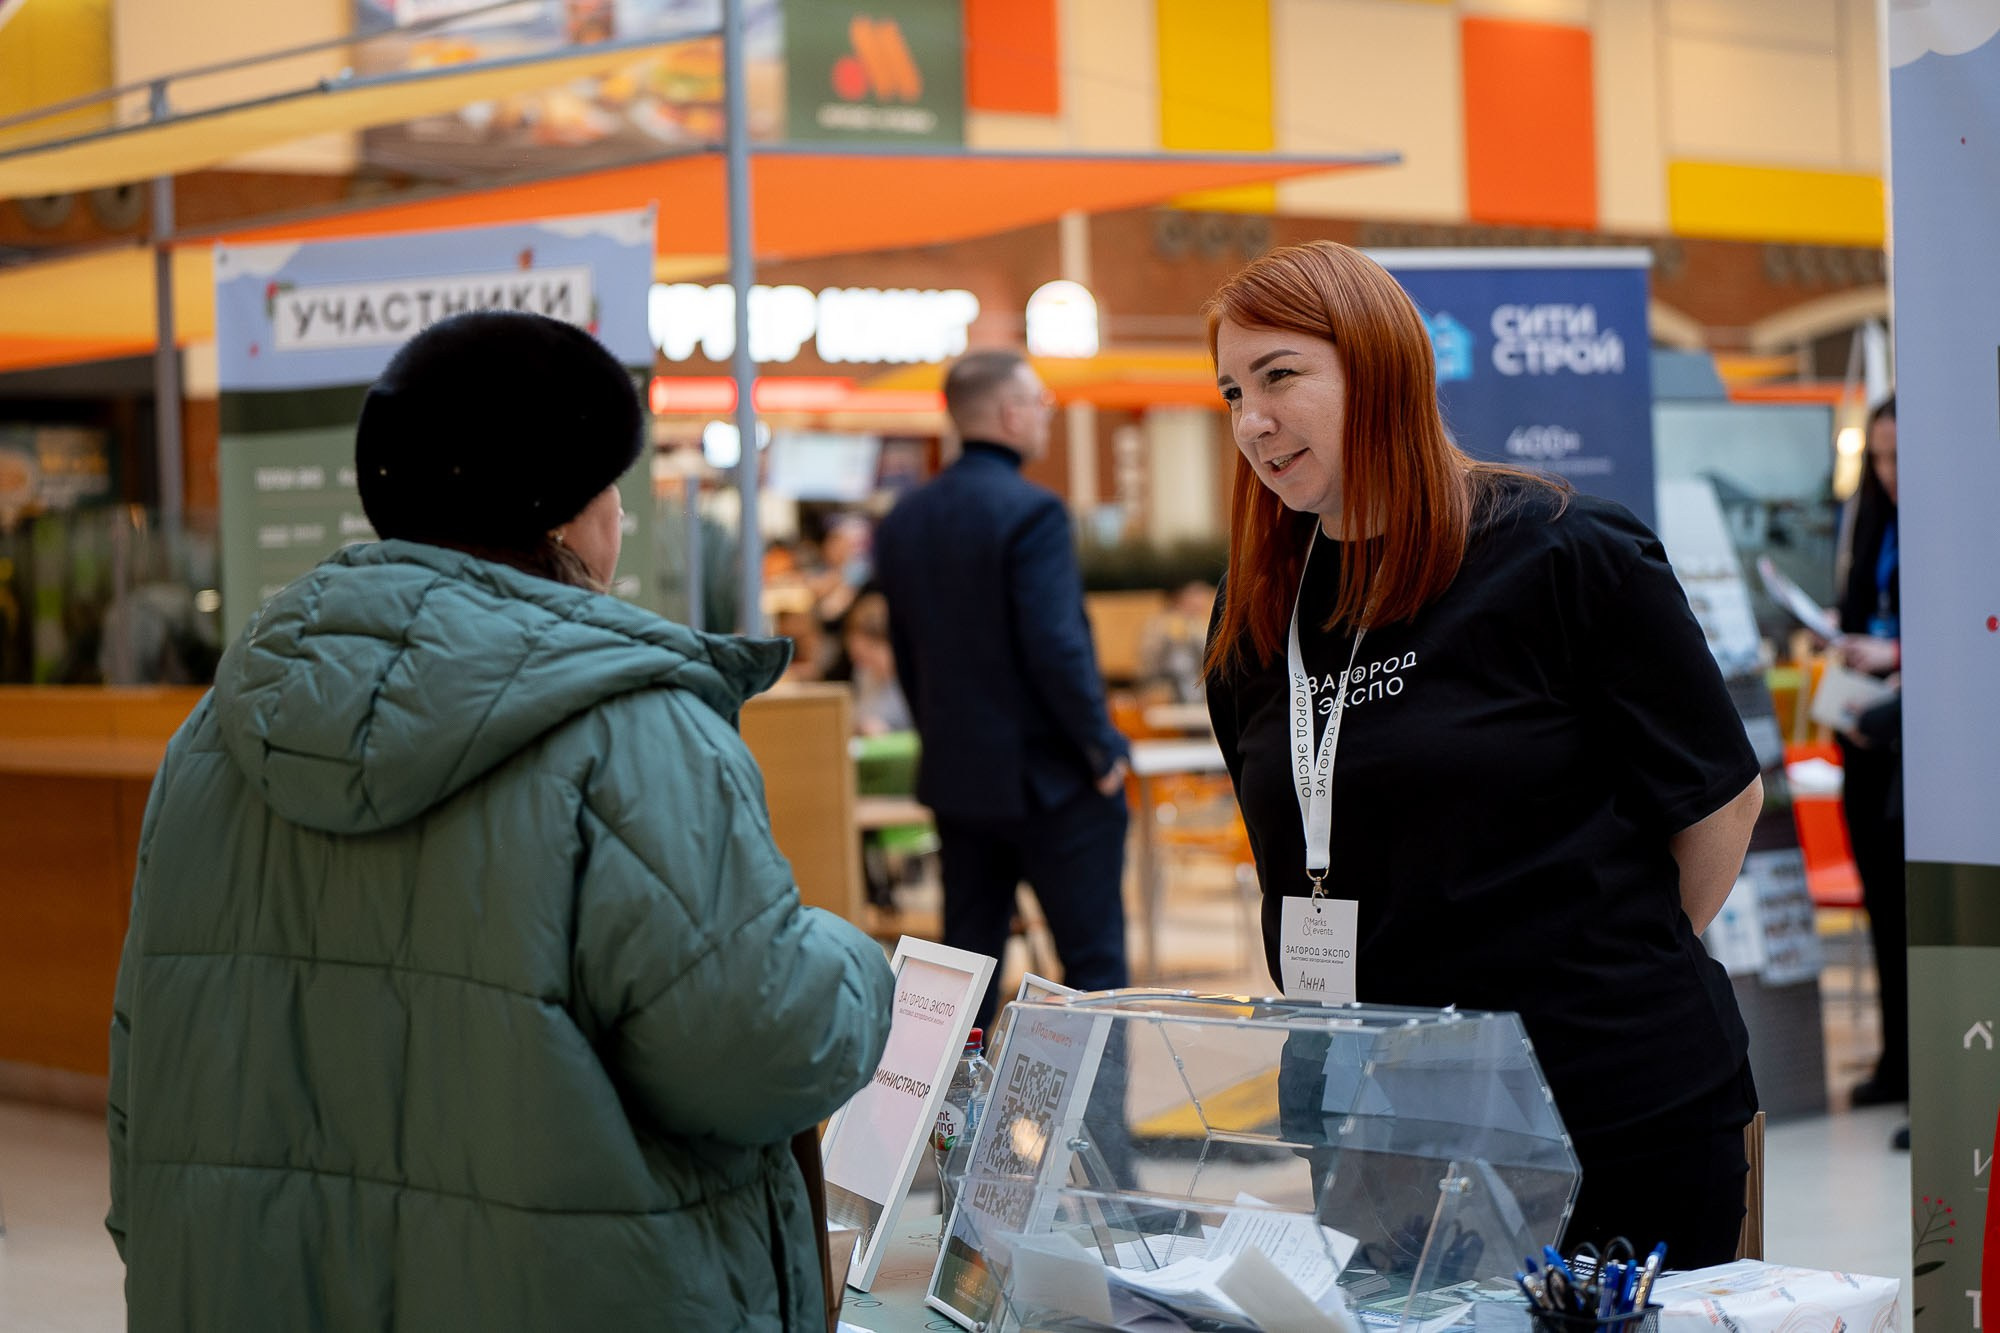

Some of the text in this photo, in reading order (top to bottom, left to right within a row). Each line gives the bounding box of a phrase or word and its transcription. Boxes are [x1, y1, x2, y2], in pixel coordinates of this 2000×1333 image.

[290, 279, 573, 339] УЧАСТНИКИ
[1491, 304, 1598, 339] СИТИ
[1491, 328, 1626, 375] СТРОЙ
[1307, 651, 1417, 696] ЗАГОРОД
[1294, 672, 1312, 798] ЗАГОРОД ЭКСПО
[1315, 726, 1336, 798] ЗАГОРОД
[1310, 918, 1327, 927] Marks
[1313, 927, 1333, 936] events
[1286, 945, 1350, 959] ЗАГОРОД ЭКСПО
[899, 990, 955, 1017] ЗАГОРОД ЭКСПО
[873, 1067, 931, 1099] МИНИСТРАТОР
